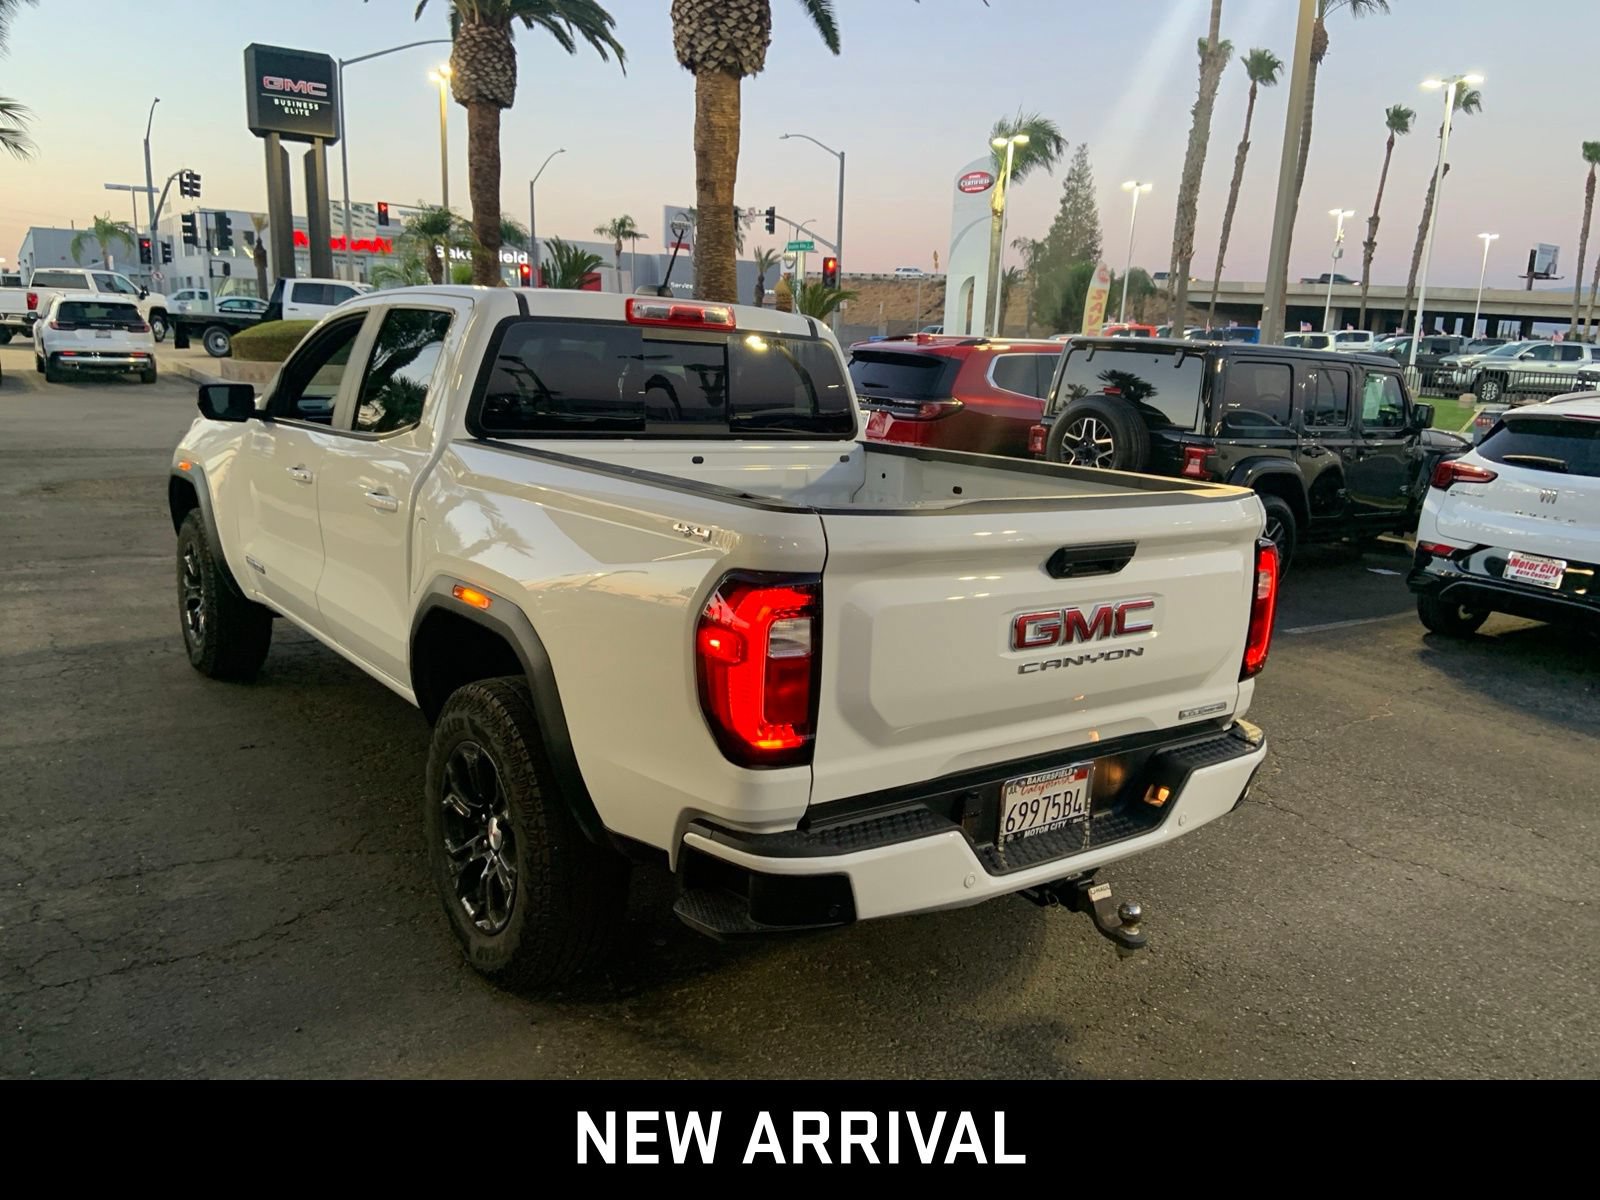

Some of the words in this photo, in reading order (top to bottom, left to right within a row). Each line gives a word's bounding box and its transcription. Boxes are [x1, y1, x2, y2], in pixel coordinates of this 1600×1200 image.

[263, 76, 327, 96] GMC
[274, 98, 319, 110] BUSINESS
[284, 107, 310, 116] ELITE
[1510, 558, 1540, 571] Motor
[1540, 563, 1561, 577] City
[1531, 571, 1552, 580] Center
[1010, 599, 1155, 652] GMC
[1017, 647, 1145, 675] CANYON
[1027, 768, 1073, 785] BAKERSFIELD
[1005, 788, 1083, 833] 69975B4
[1024, 825, 1049, 839] MOTOR
[1050, 819, 1067, 831] CITY
